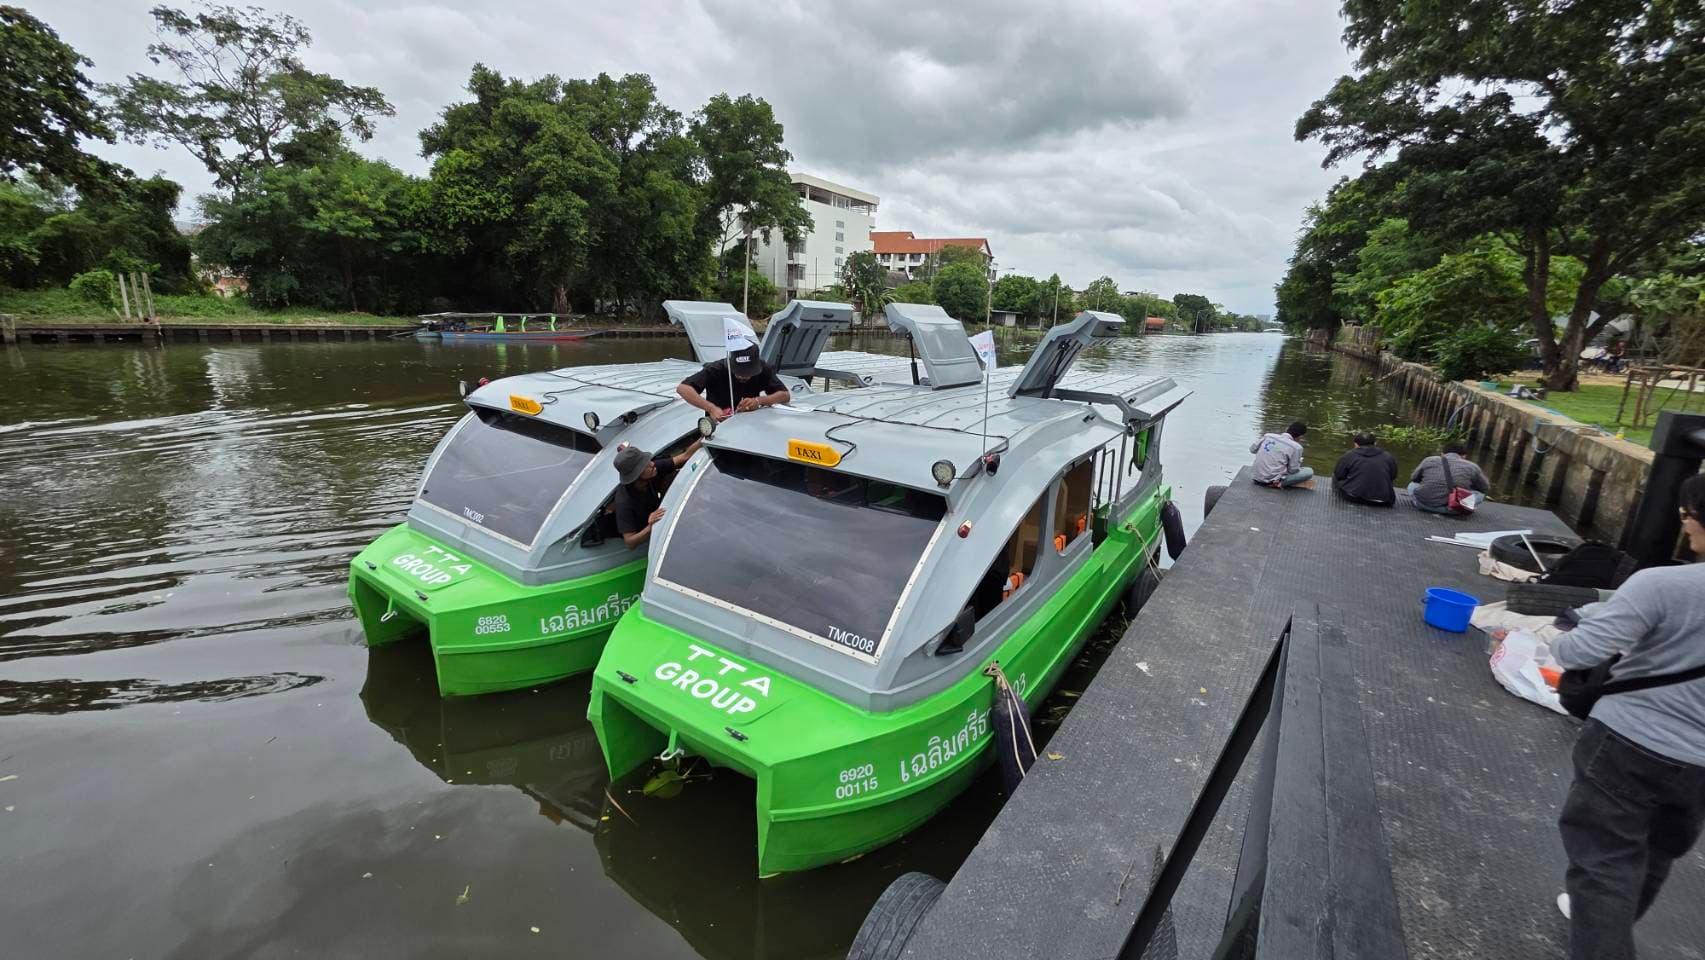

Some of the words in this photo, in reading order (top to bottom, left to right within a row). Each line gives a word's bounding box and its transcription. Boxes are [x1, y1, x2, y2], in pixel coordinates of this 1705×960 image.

[795, 447, 822, 460] TAXI
[392, 553, 453, 585] GROUP
[475, 622, 511, 635] 00553
[478, 614, 507, 626] 6820
[828, 625, 875, 653] TMC008
[655, 662, 756, 714] GROUP
[900, 707, 992, 782] เฉลิมศรีธ
[839, 763, 874, 783] 6920
[835, 776, 879, 799] 00115
